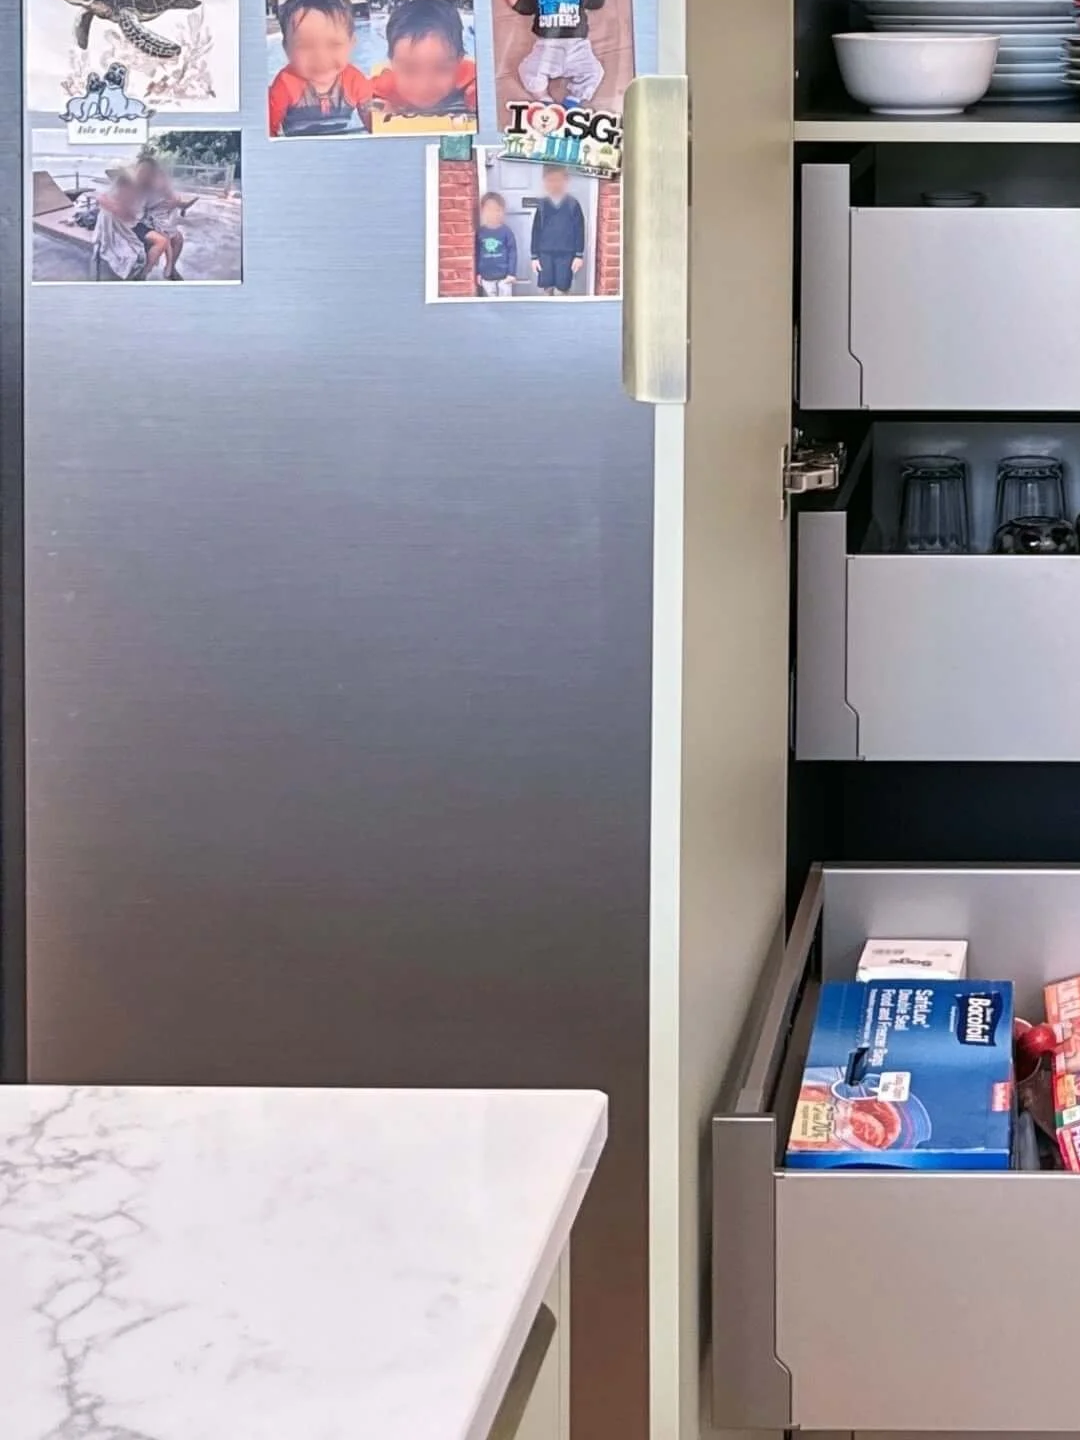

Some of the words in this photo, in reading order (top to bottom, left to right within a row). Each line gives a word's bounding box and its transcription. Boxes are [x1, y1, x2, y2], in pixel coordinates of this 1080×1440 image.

[78, 125, 96, 134] Isle
[99, 125, 112, 136] of
[113, 125, 137, 134] Iona
[508, 104, 529, 134] I
[879, 989, 896, 1007] Food
[965, 997, 991, 1044] Bacofoil
